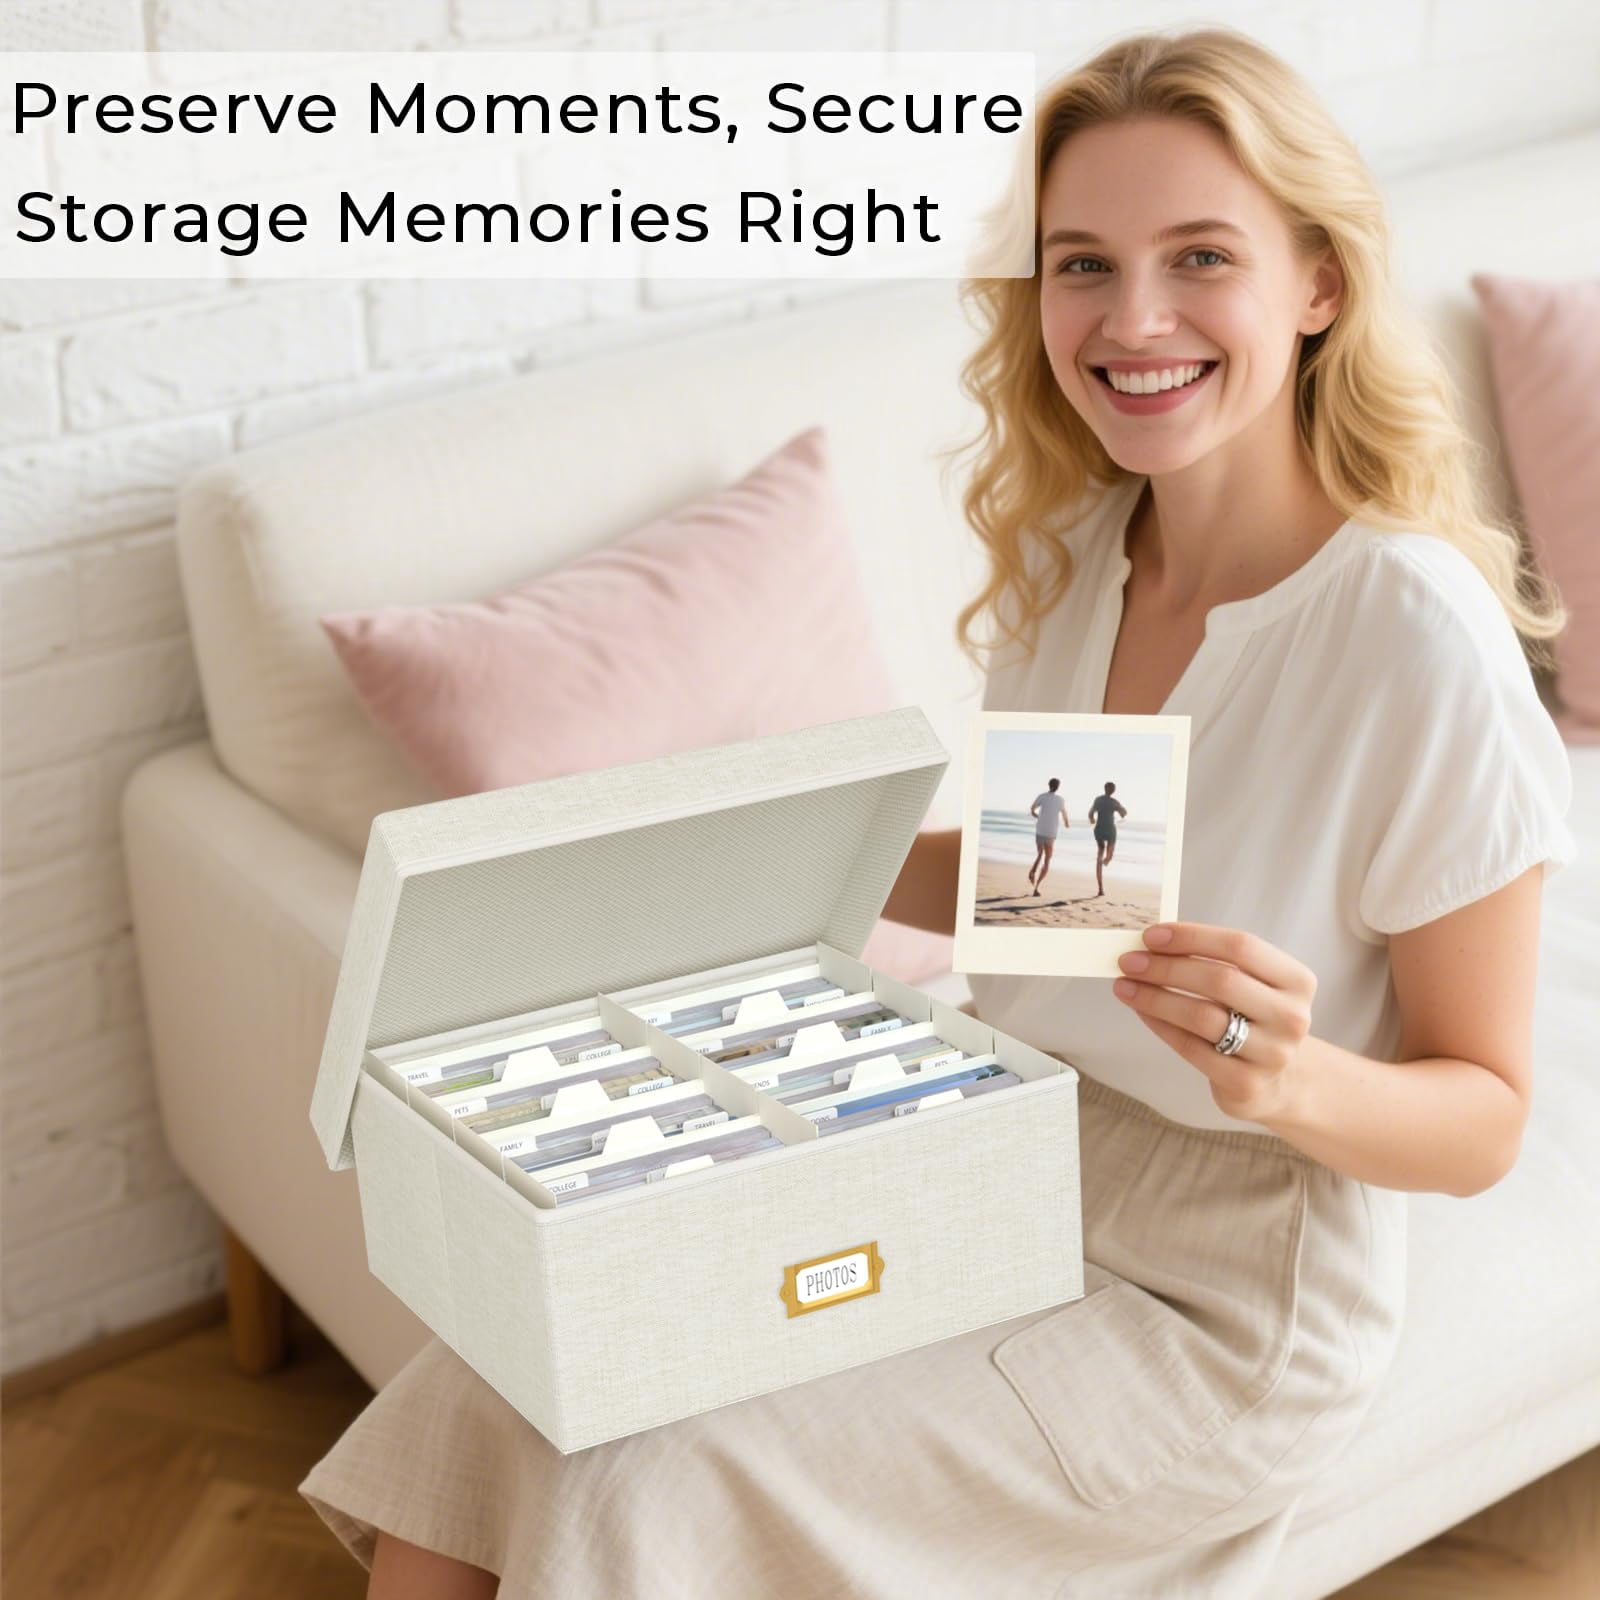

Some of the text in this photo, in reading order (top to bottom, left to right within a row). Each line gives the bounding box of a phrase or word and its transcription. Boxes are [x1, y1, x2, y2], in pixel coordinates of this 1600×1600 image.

[407, 1071, 430, 1081] TRAVEL
[453, 1106, 470, 1115] PETS
[499, 1141, 524, 1152] FAMILY
[806, 1262, 857, 1297] PHOTOS
